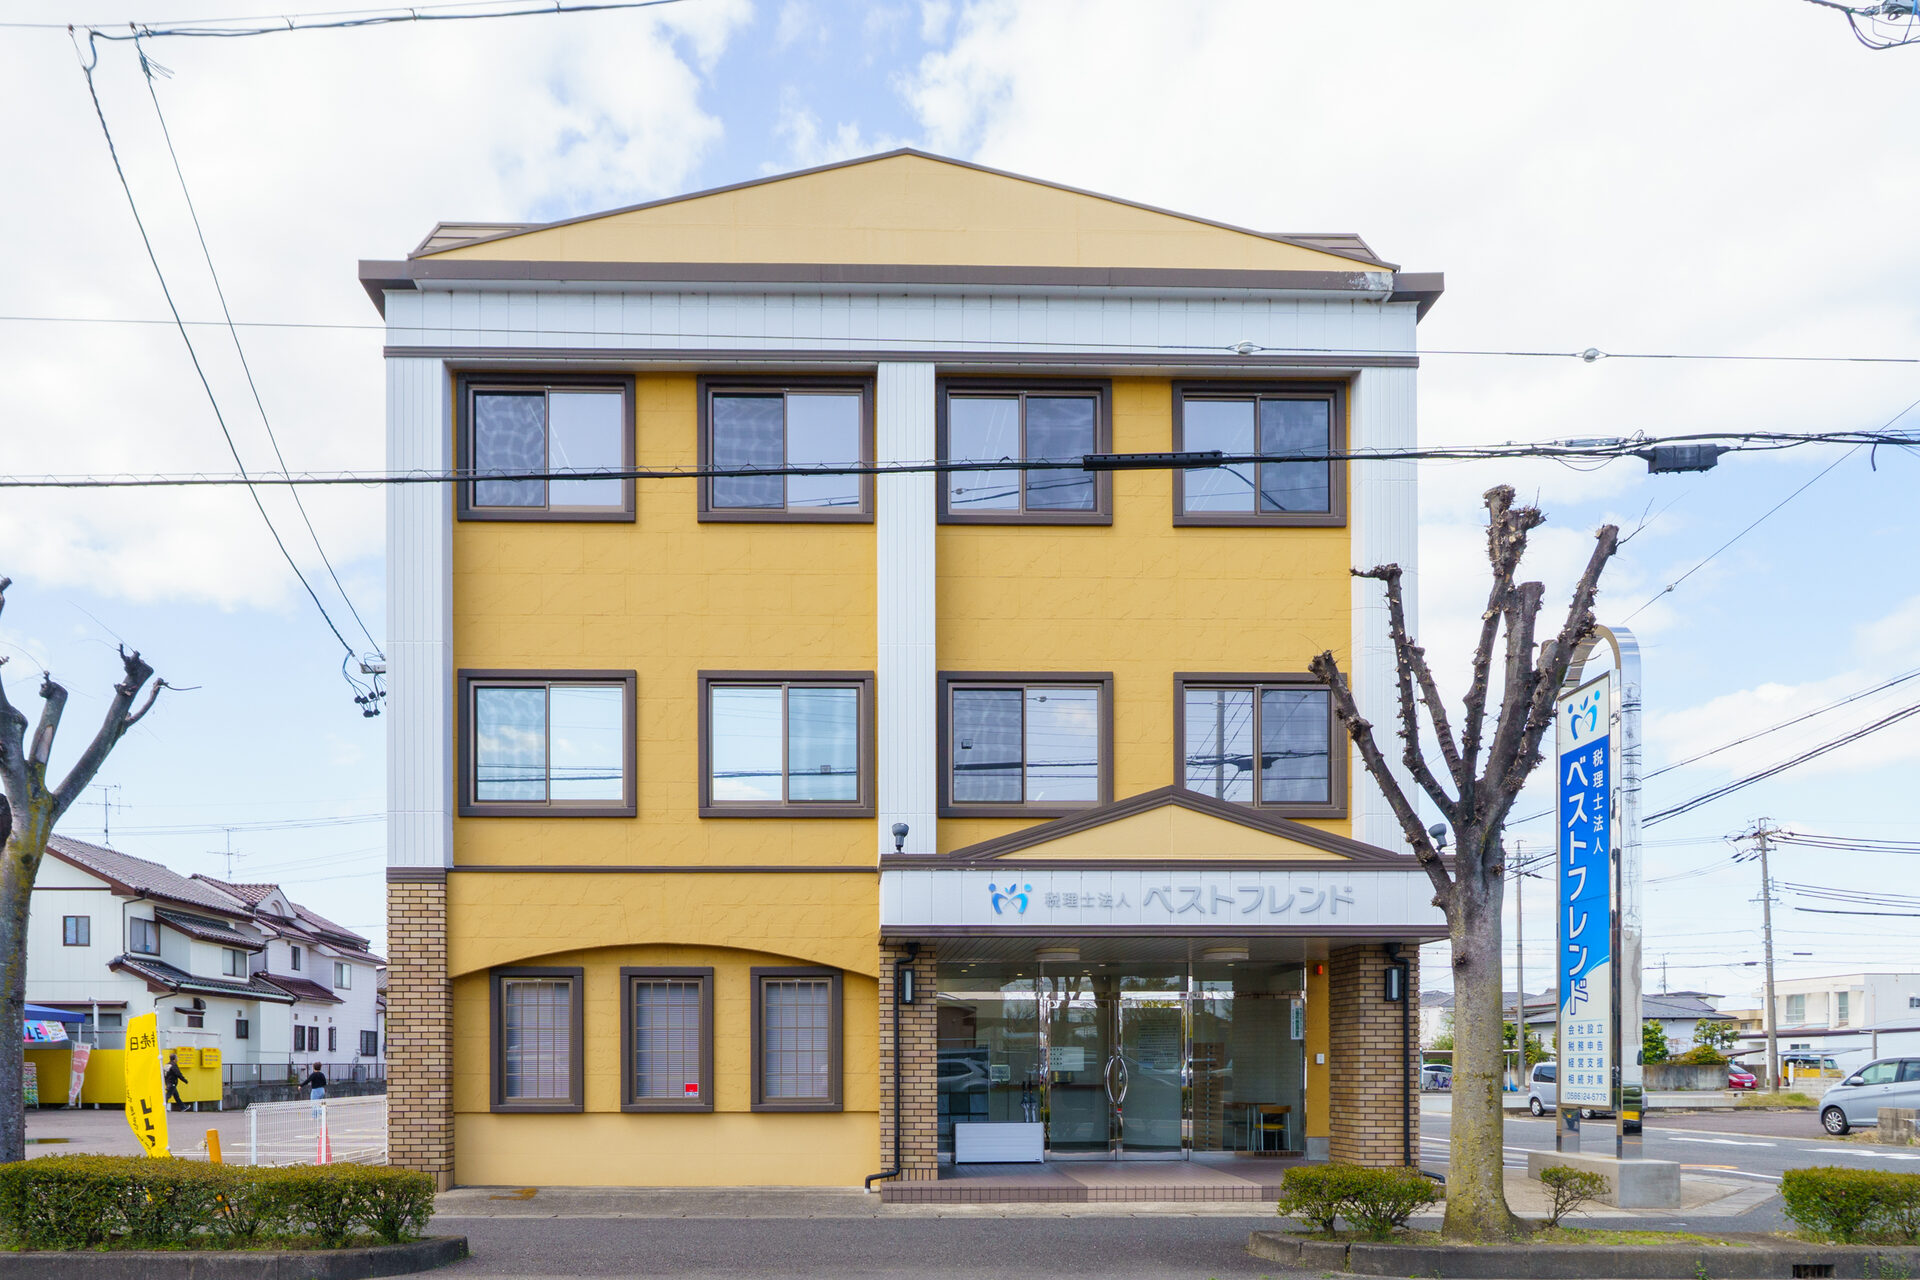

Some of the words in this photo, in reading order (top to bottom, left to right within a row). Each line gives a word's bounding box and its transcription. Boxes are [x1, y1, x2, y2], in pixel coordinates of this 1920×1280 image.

[1592, 749, 1604, 855] 税理士法人
[1566, 756, 1589, 1016] ベストフレンド
[1044, 892, 1130, 909] 税理士法人
[1143, 884, 1355, 915] ベストフレンド
[1568, 1024, 1603, 1034] 会社設立
[1568, 1041, 1603, 1051] 税務申告
[1568, 1058, 1603, 1068] 経営支援
[1568, 1075, 1603, 1085] 相続対策
